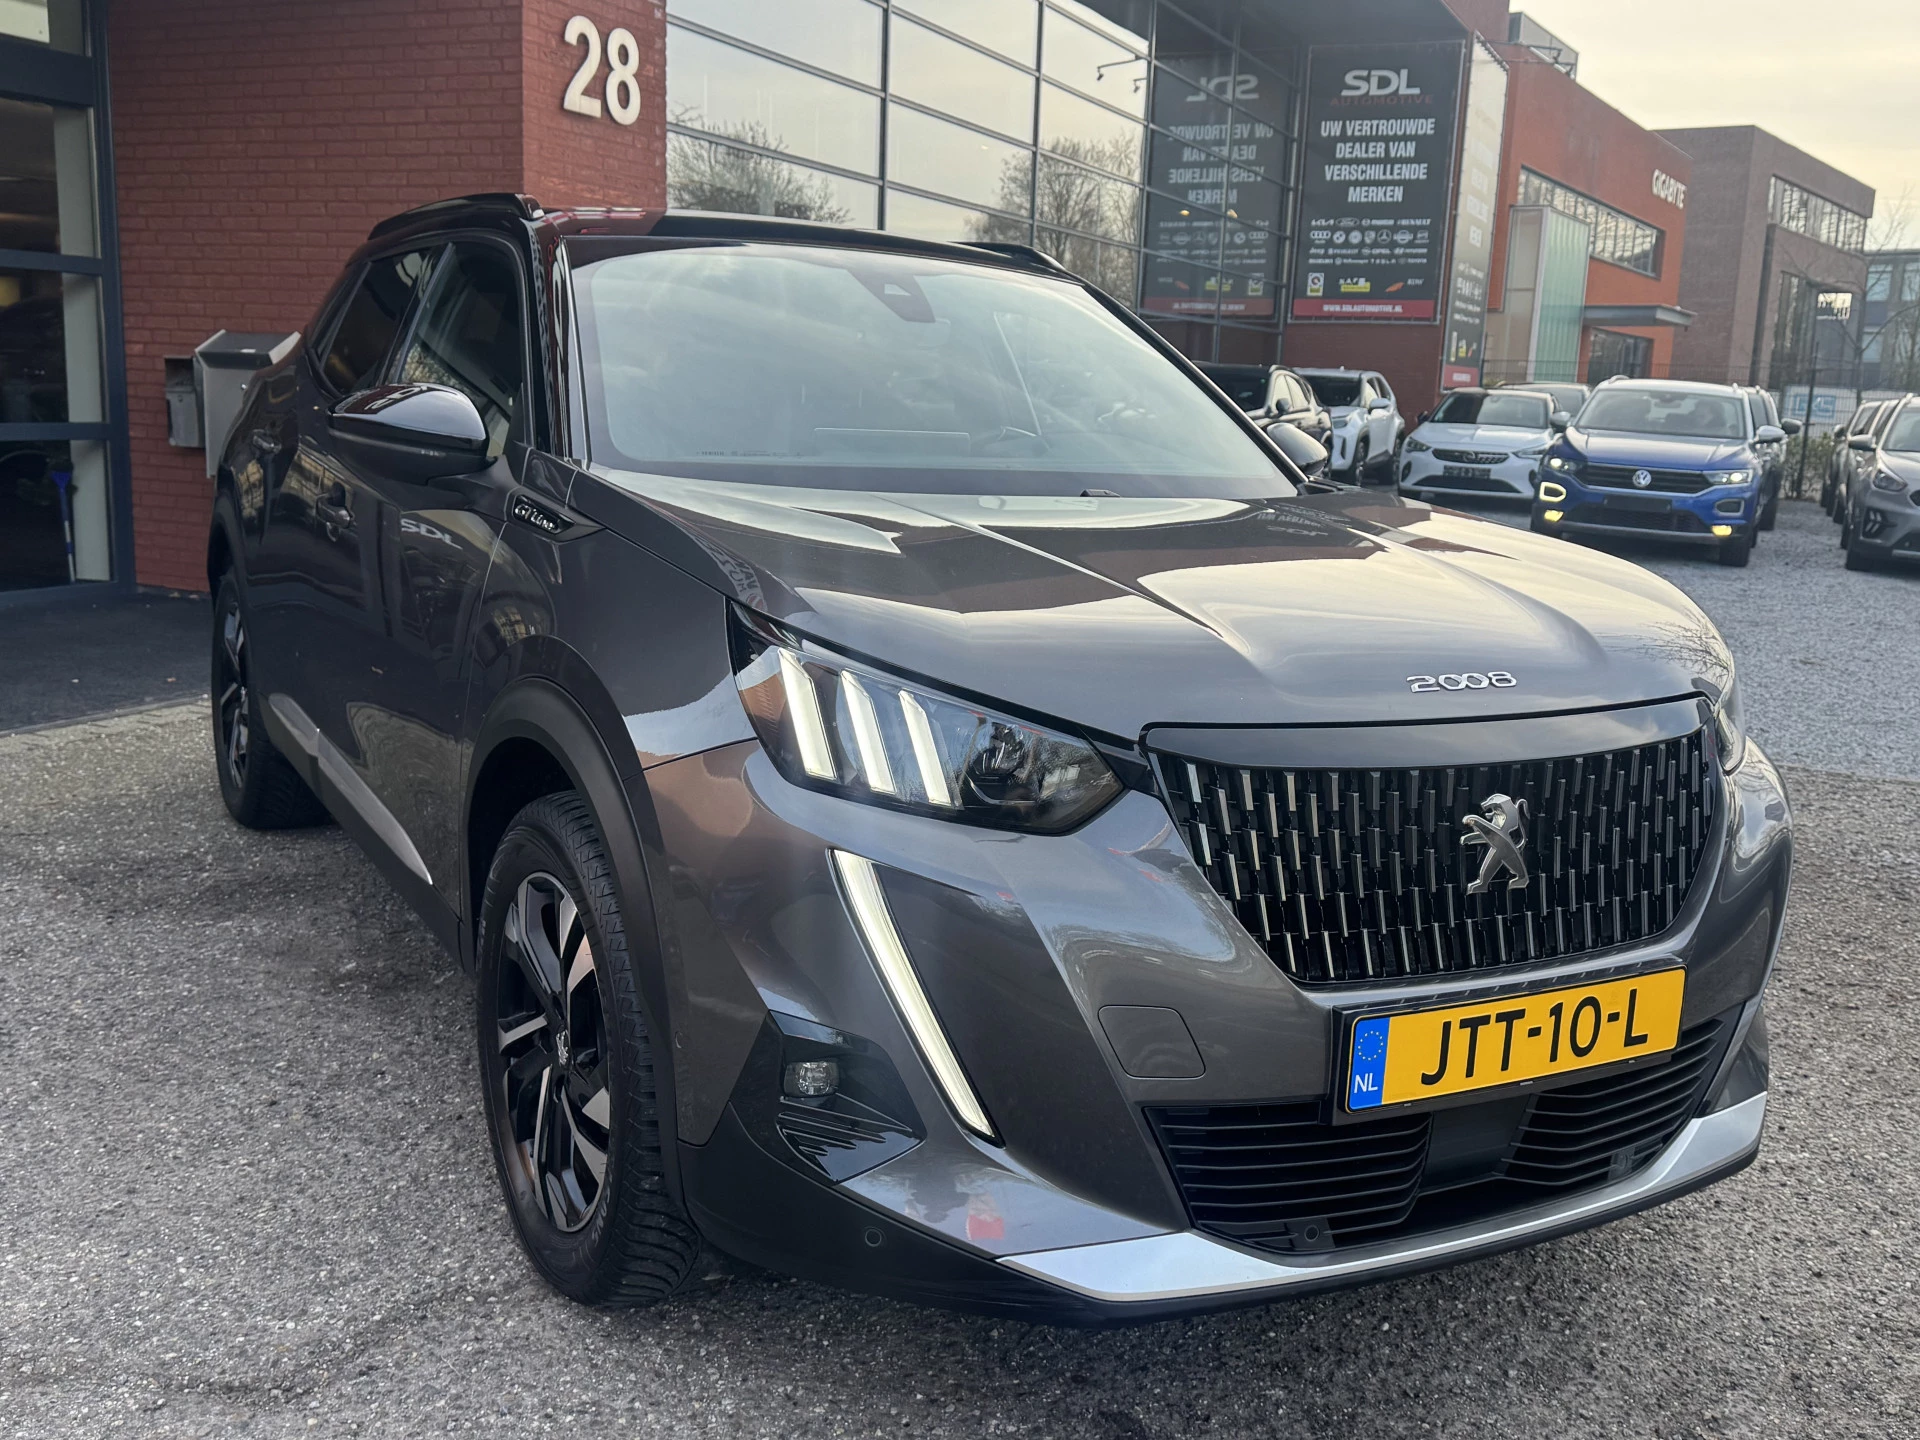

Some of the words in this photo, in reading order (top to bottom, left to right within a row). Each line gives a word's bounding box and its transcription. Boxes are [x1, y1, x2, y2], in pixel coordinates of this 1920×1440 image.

[563, 14, 641, 126] 28
[1341, 69, 1421, 96] SDL
[1330, 94, 1434, 106] AUTOMOTIVE
[1320, 121, 1343, 137] UW
[1346, 118, 1436, 136] VERTROUWDE
[1336, 141, 1385, 158] DEALER
[1389, 141, 1416, 157] VAN
[1324, 163, 1428, 181] VERSCHILLENDE
[1348, 186, 1403, 202] MERKEN
[1651, 168, 1688, 210] GIGABYTE
[1406, 671, 1517, 693] 2008
[1420, 988, 1649, 1086] JTT-10-L
[1353, 1073, 1378, 1094] NL
